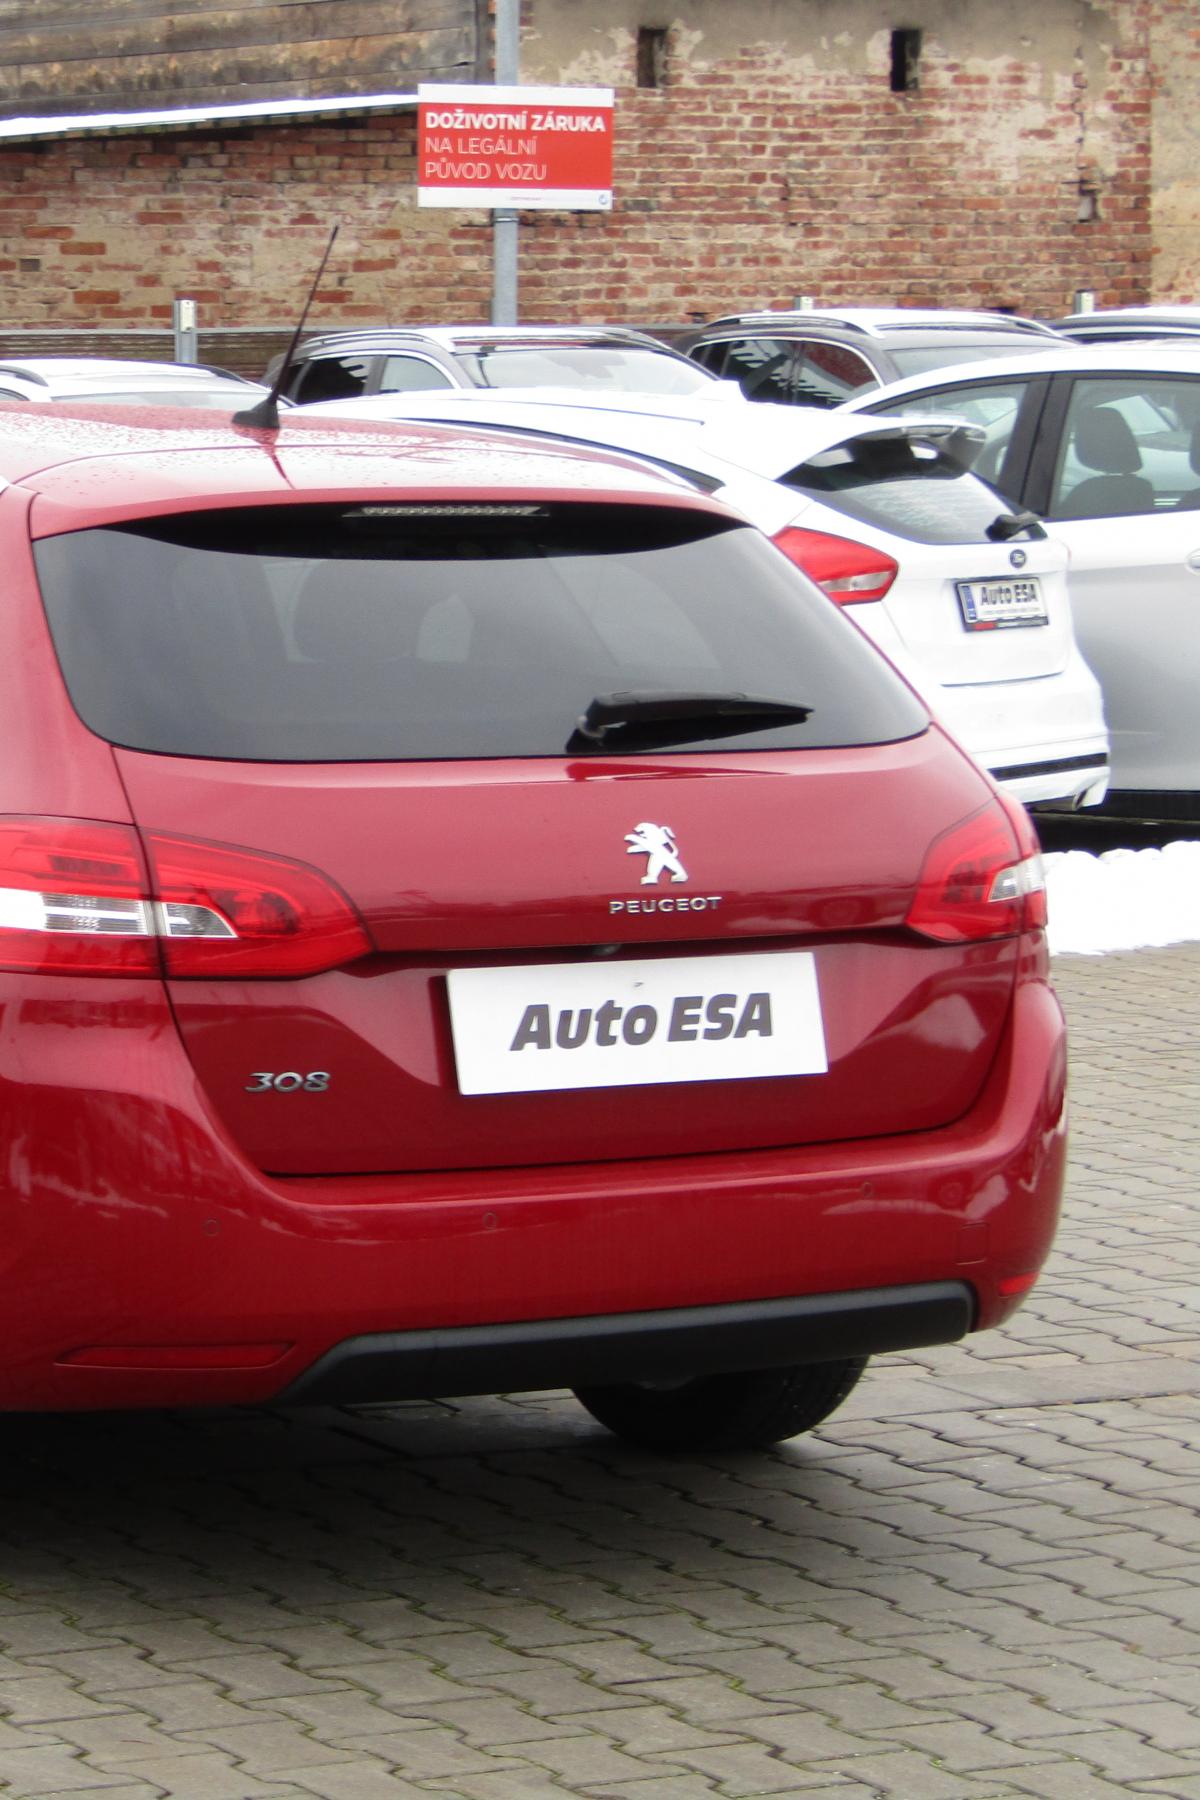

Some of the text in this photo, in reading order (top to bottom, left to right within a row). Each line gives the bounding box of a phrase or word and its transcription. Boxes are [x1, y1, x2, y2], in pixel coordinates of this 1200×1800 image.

[425, 109, 606, 132] DOŽIVOTNÍ ZÁRUKA
[425, 135, 537, 155] NA LEGÁLNÍ
[425, 157, 547, 180] PŮVOD VOZU
[981, 584, 1038, 605] Auto ESA
[609, 896, 722, 914] PEUGEOT
[510, 992, 773, 1051] Auto ESA
[246, 1071, 331, 1092] 308
